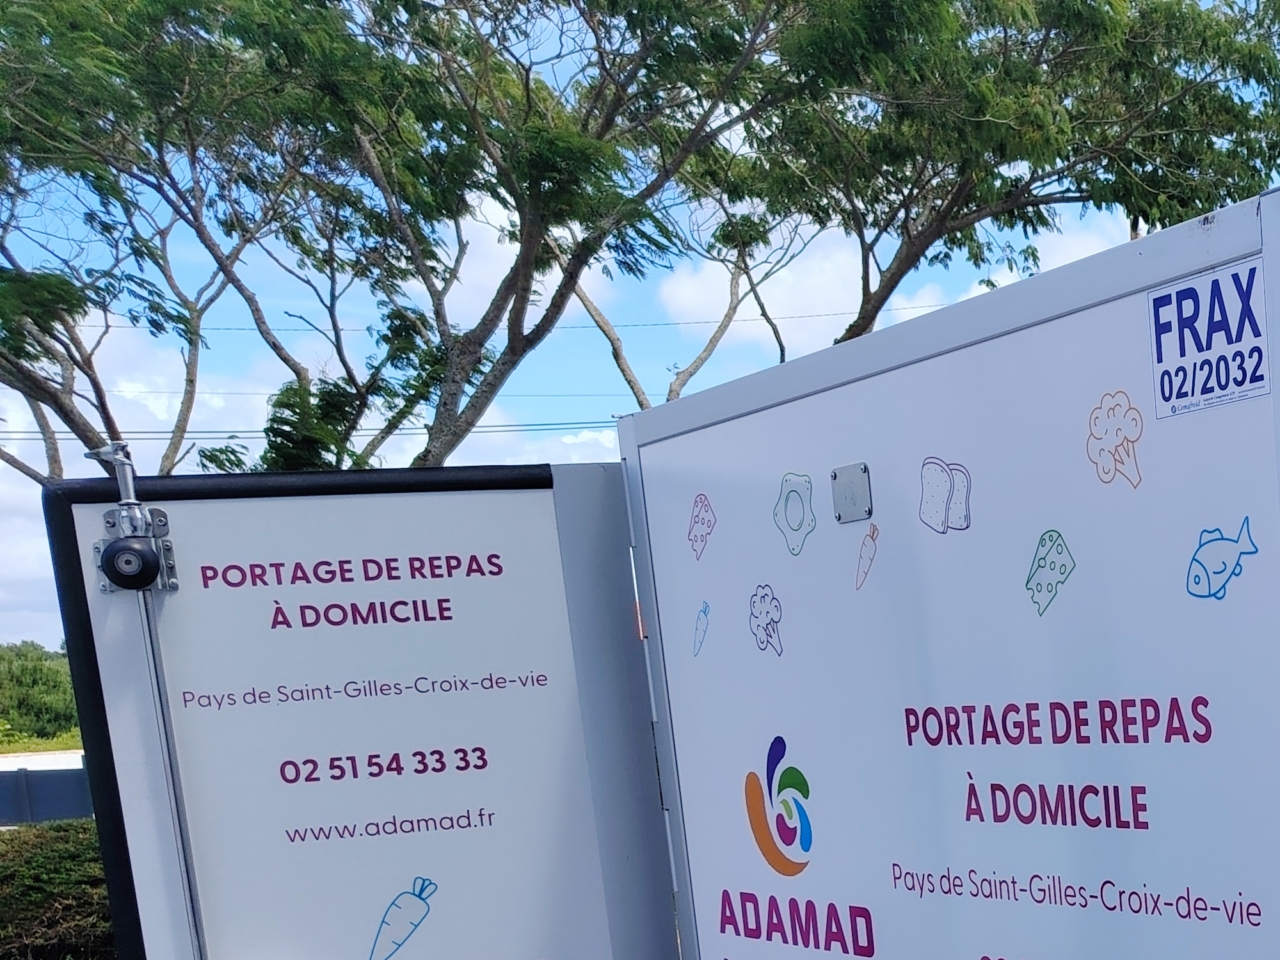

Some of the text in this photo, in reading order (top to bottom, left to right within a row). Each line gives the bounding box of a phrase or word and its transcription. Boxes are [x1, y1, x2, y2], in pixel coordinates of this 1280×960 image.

[1153, 267, 1261, 364] FRAX
[1160, 346, 1264, 402] 02/2032
[201, 554, 502, 588] PORTAGE DE REPAS
[271, 599, 452, 629] À DOMICILE
[183, 671, 547, 710] Pays de Saint-Gilles-Croix-de-vie
[905, 696, 1211, 746] PORTAGE DE REPAS
[280, 747, 487, 783] 02 51 54 33 33
[286, 808, 495, 842] www.adamad.fr
[966, 772, 1148, 829] À DOMICILE
[893, 863, 1261, 926] Pays de Saint-Gilles-Croix-de-vie
[720, 890, 874, 958] ADAMAD
